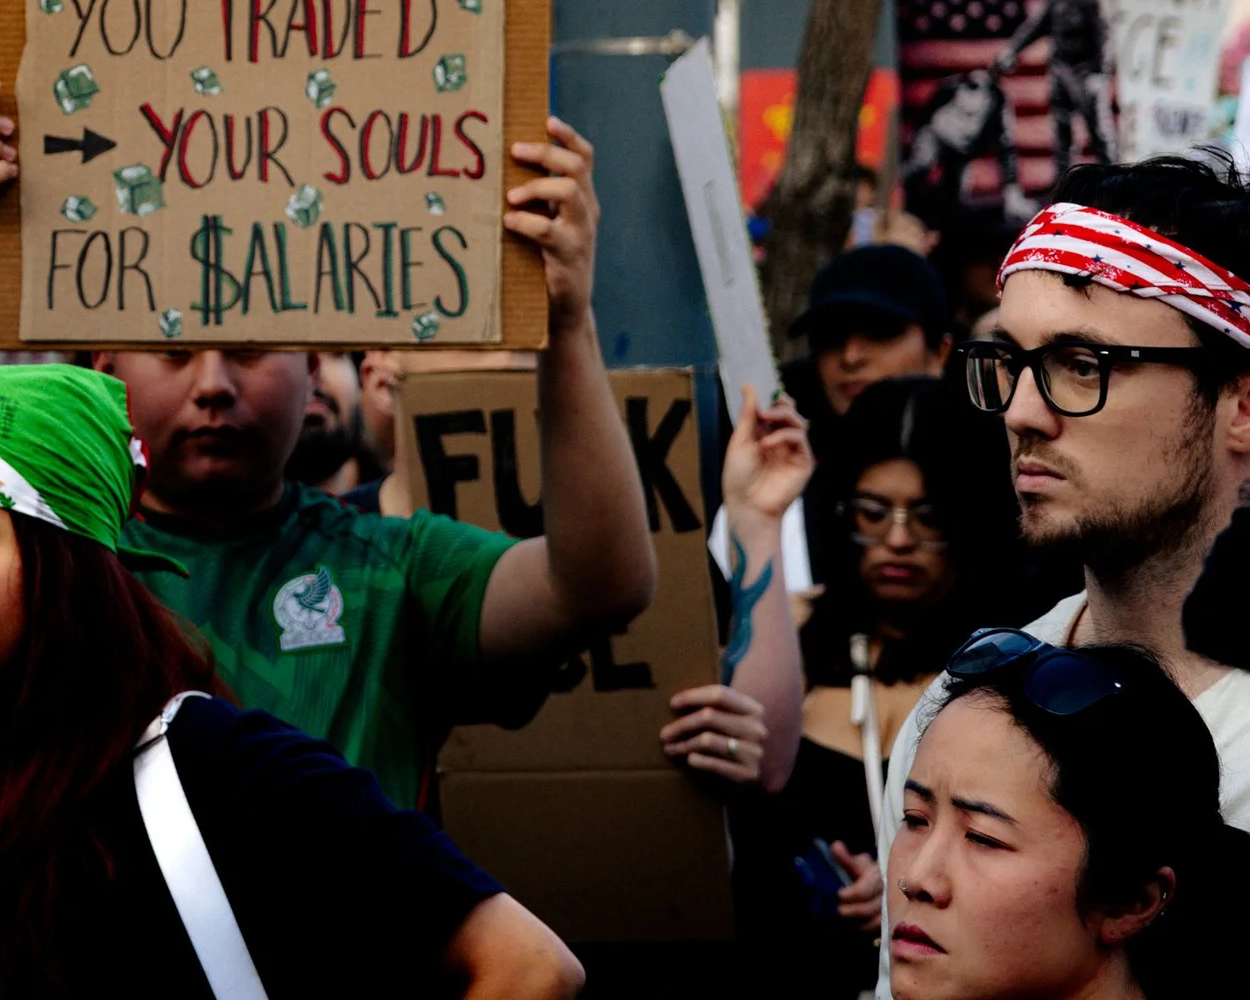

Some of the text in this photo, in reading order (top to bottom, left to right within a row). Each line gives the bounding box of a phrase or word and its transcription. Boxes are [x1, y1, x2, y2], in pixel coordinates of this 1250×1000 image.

[139, 103, 489, 188] YOUR SOULS
[46, 214, 469, 327] FOR $ALARIES
[413, 396, 703, 538] FUK
